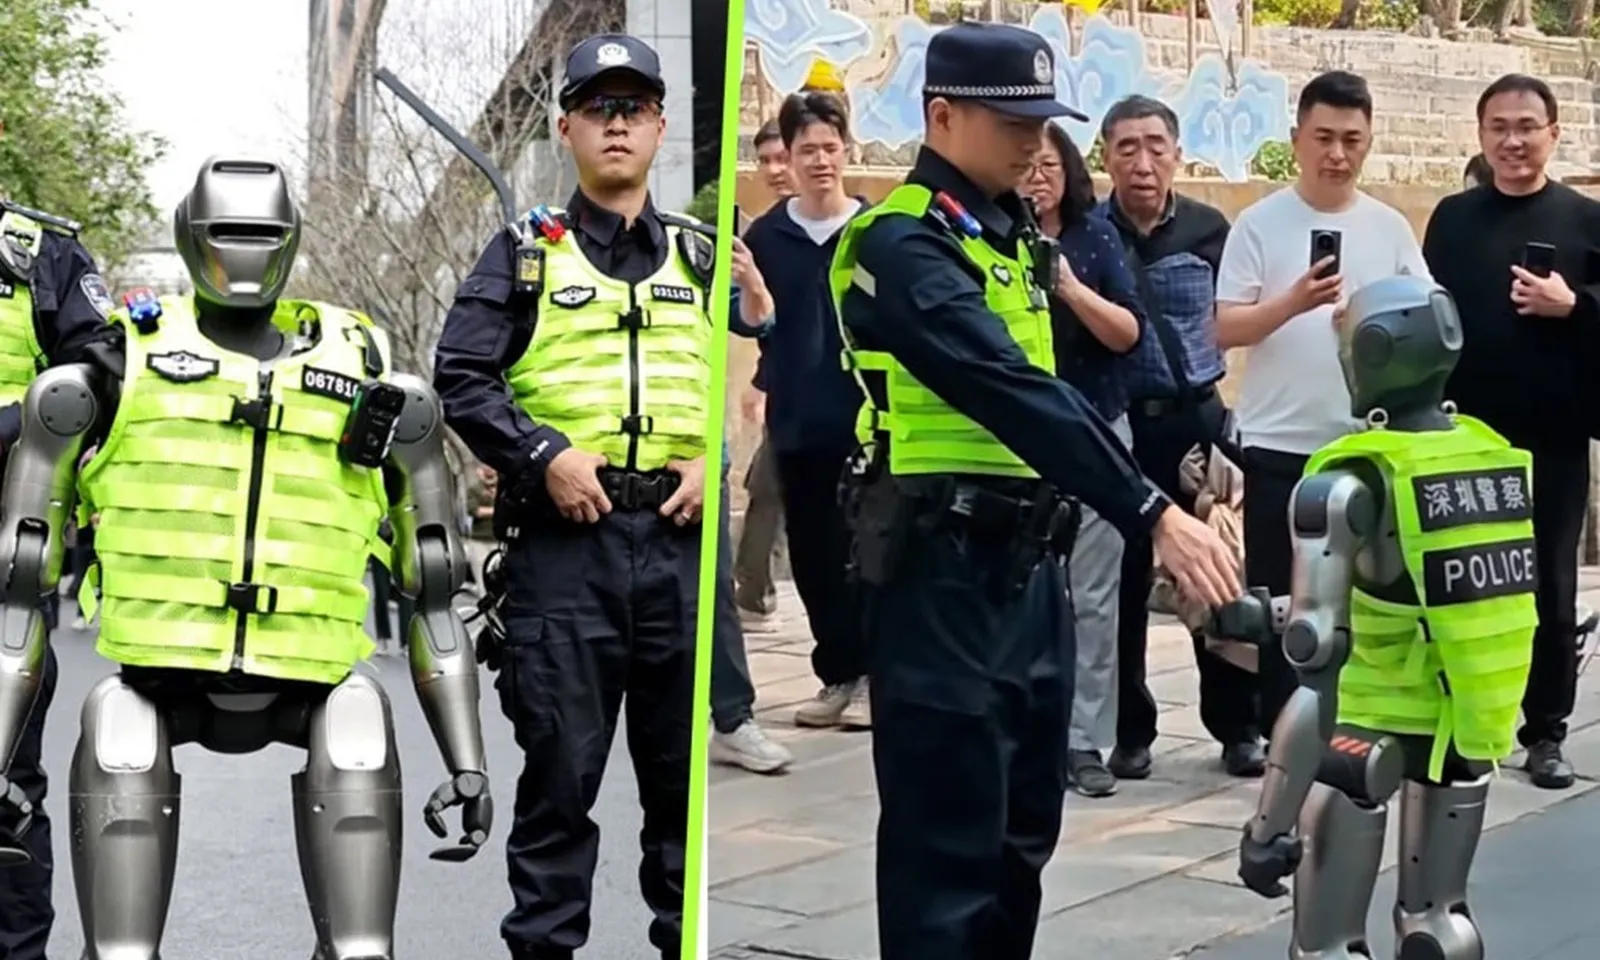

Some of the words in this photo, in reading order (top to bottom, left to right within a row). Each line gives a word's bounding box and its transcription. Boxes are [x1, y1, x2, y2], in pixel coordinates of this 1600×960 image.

[1424, 475, 1526, 519] 深圳警察
[1443, 548, 1534, 593] POLICE
